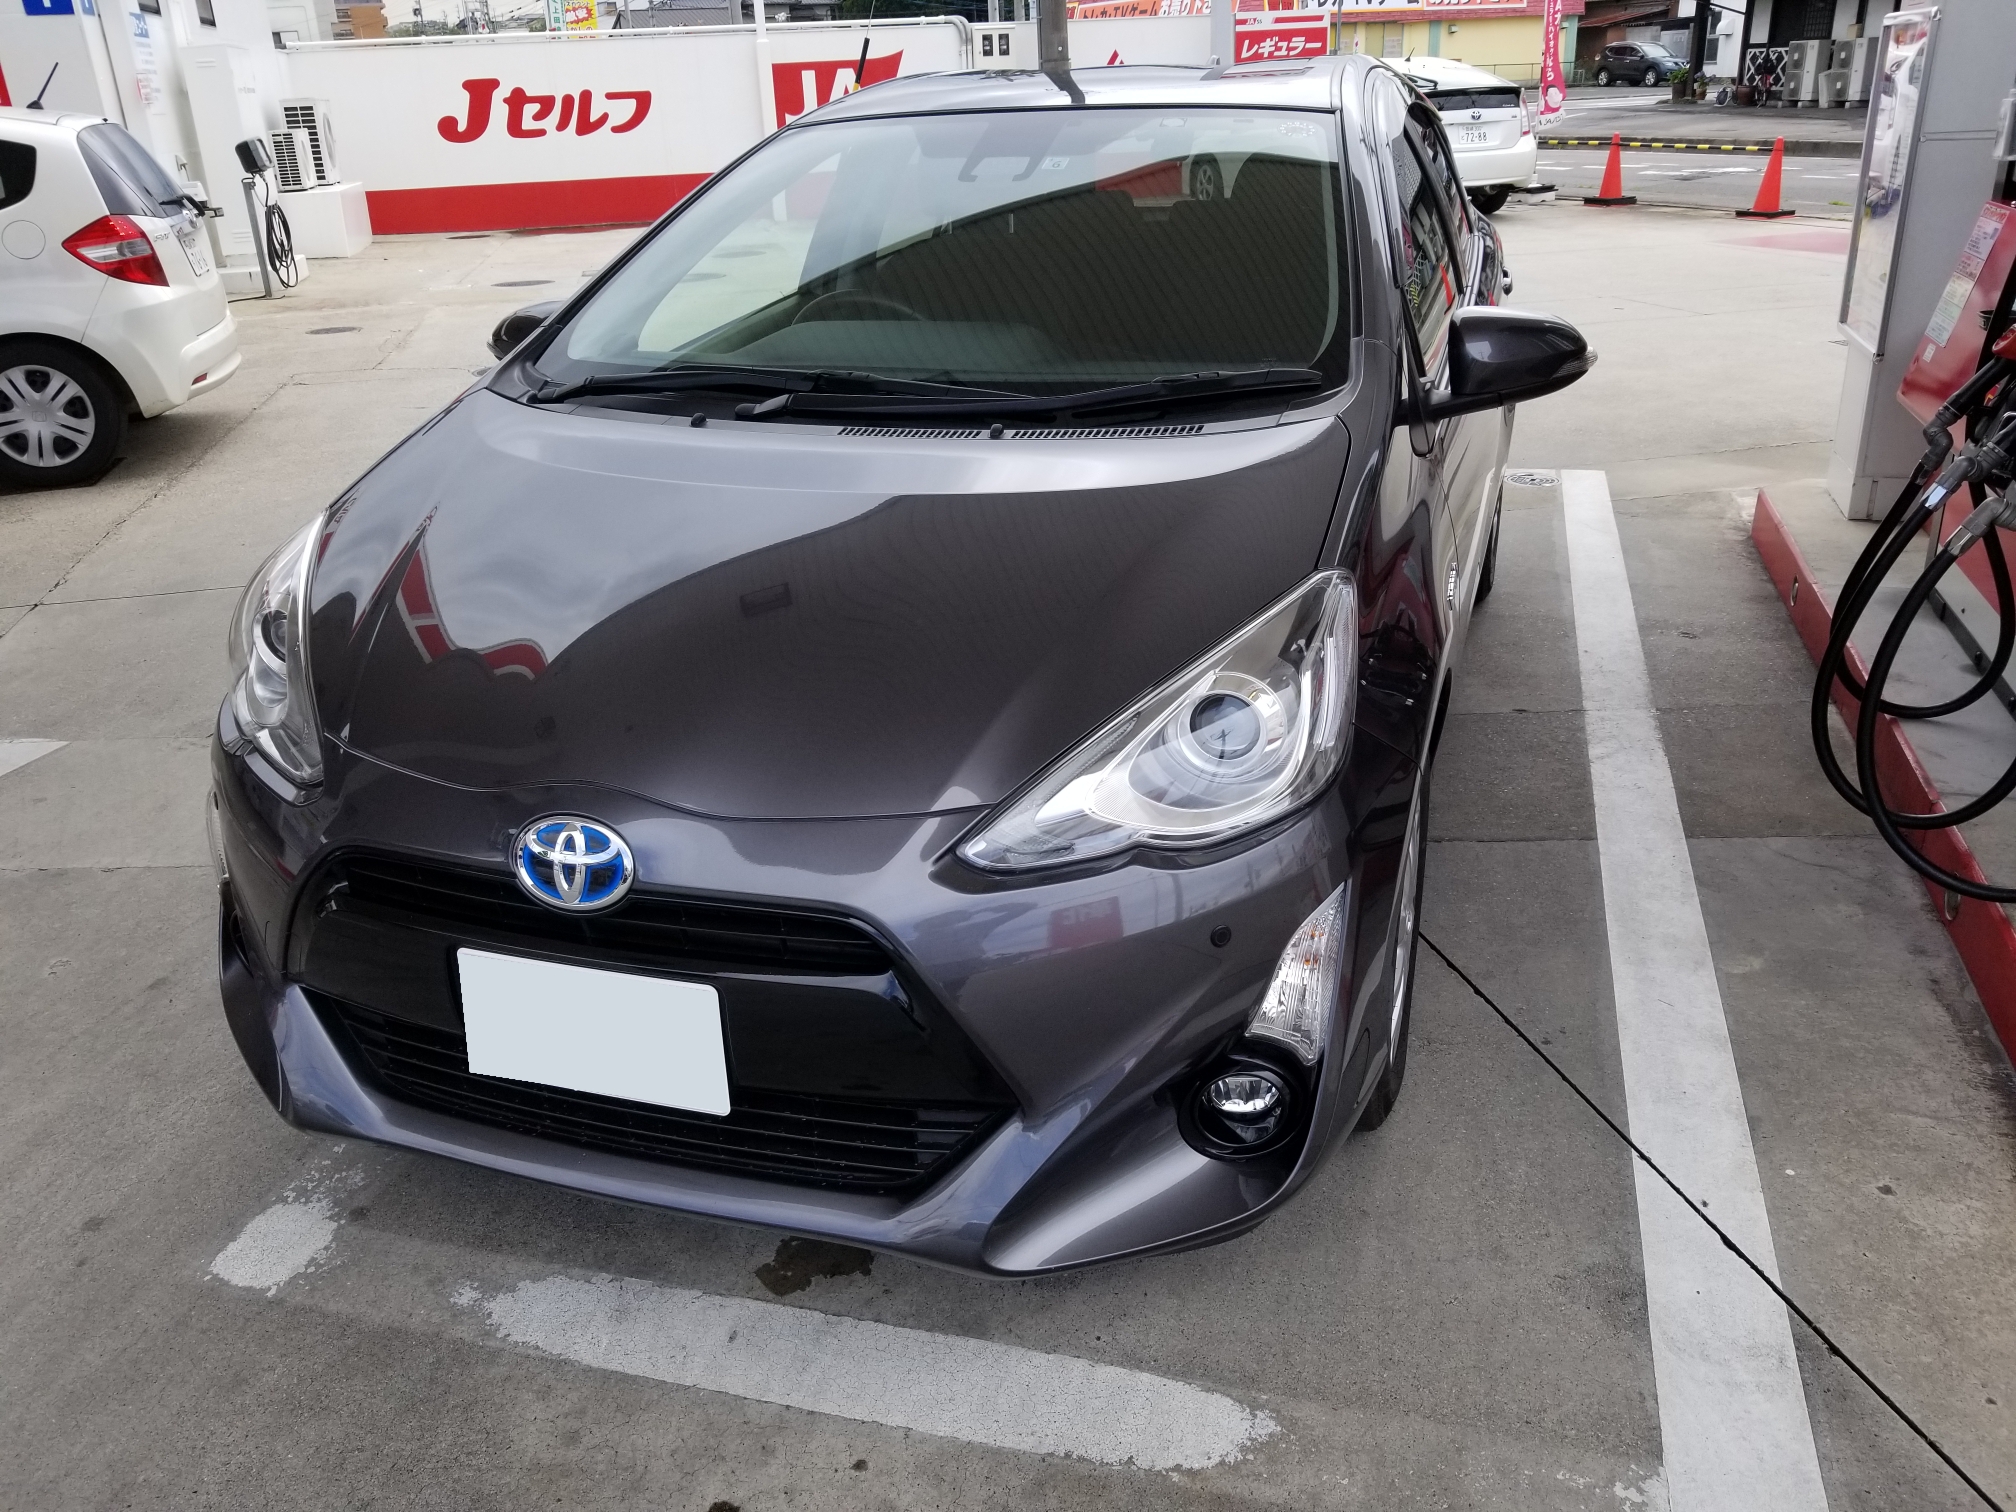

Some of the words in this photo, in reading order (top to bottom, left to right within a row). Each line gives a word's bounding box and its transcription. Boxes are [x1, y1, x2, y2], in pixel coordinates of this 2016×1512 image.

[1241, 36, 1322, 59] レギュラー
[785, 68, 862, 125] JA
